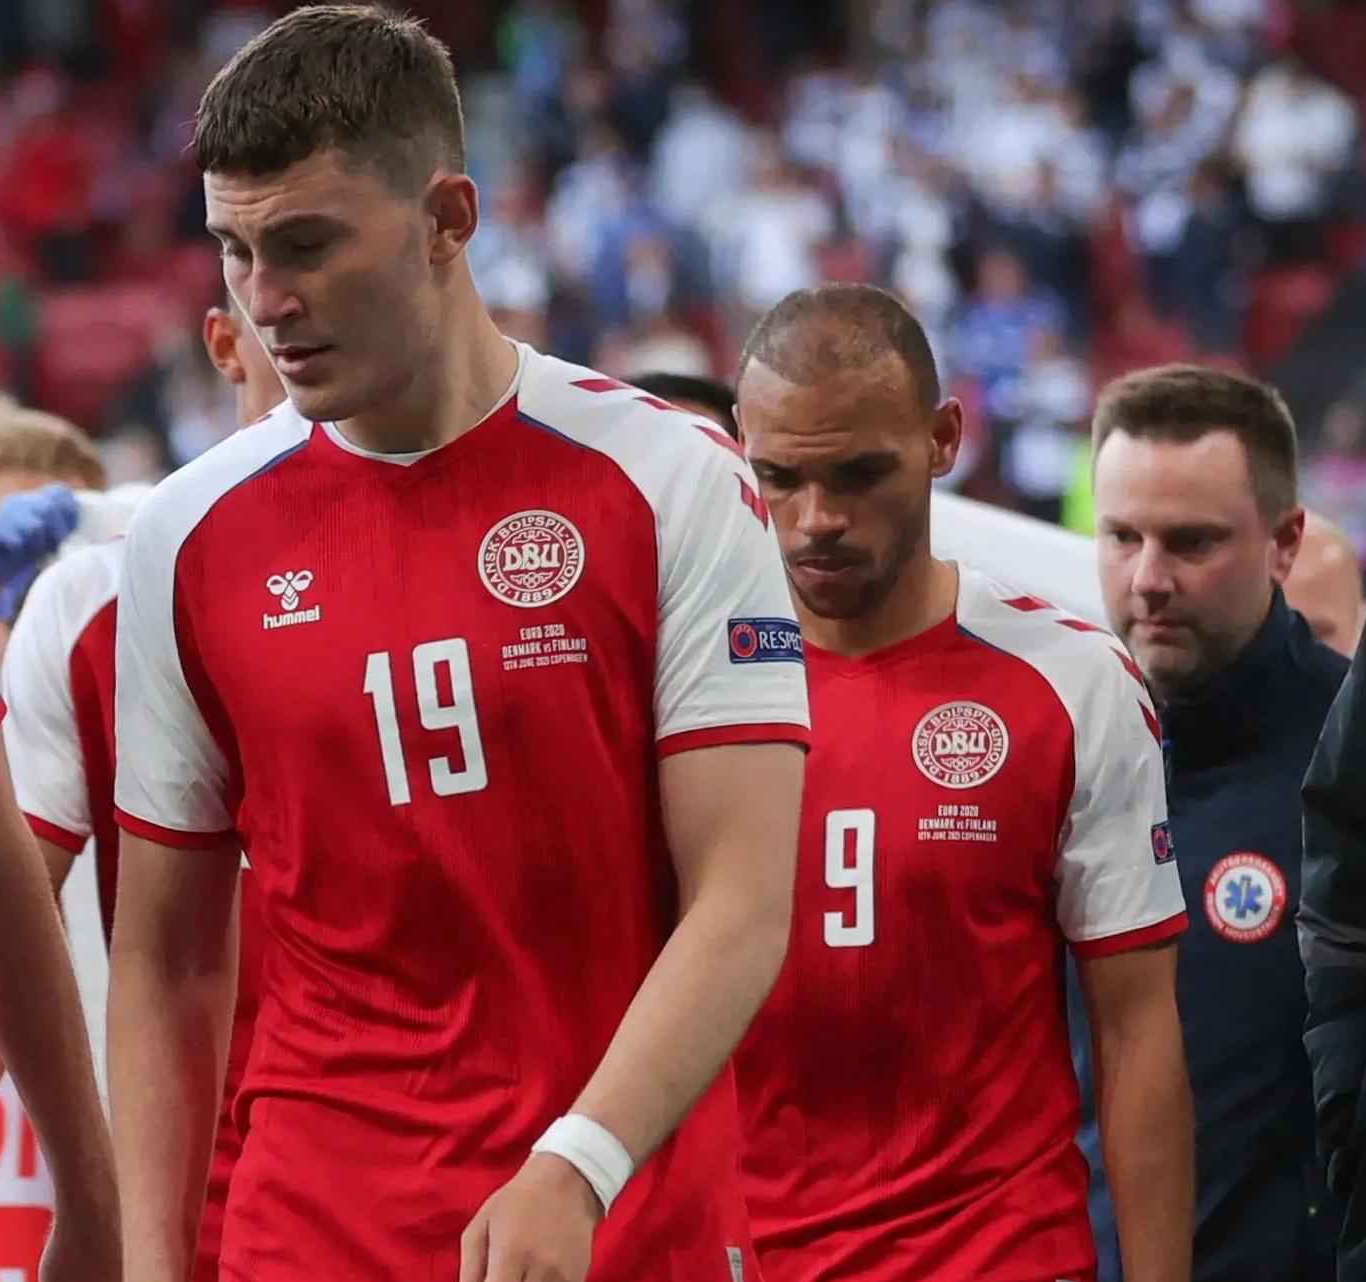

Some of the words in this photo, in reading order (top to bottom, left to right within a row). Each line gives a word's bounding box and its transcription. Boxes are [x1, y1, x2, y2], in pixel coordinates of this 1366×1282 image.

[485, 542, 510, 594] DANSK
[503, 542, 561, 571] DBU
[512, 589, 553, 602] 1889
[263, 604, 320, 630] hummel
[520, 625, 543, 640] EURO
[544, 623, 565, 637] 2020
[502, 642, 542, 658] DENMARK
[552, 638, 587, 652] FINLAND
[362, 636, 489, 807] 19
[918, 727, 940, 775] DANSK
[935, 731, 986, 755] DBU
[943, 772, 979, 784] 1889
[938, 805, 958, 816] EURO
[960, 805, 979, 817] 2020
[918, 818, 955, 830] DENMARK
[965, 819, 997, 831] FINLAND
[823, 807, 876, 948] 9
